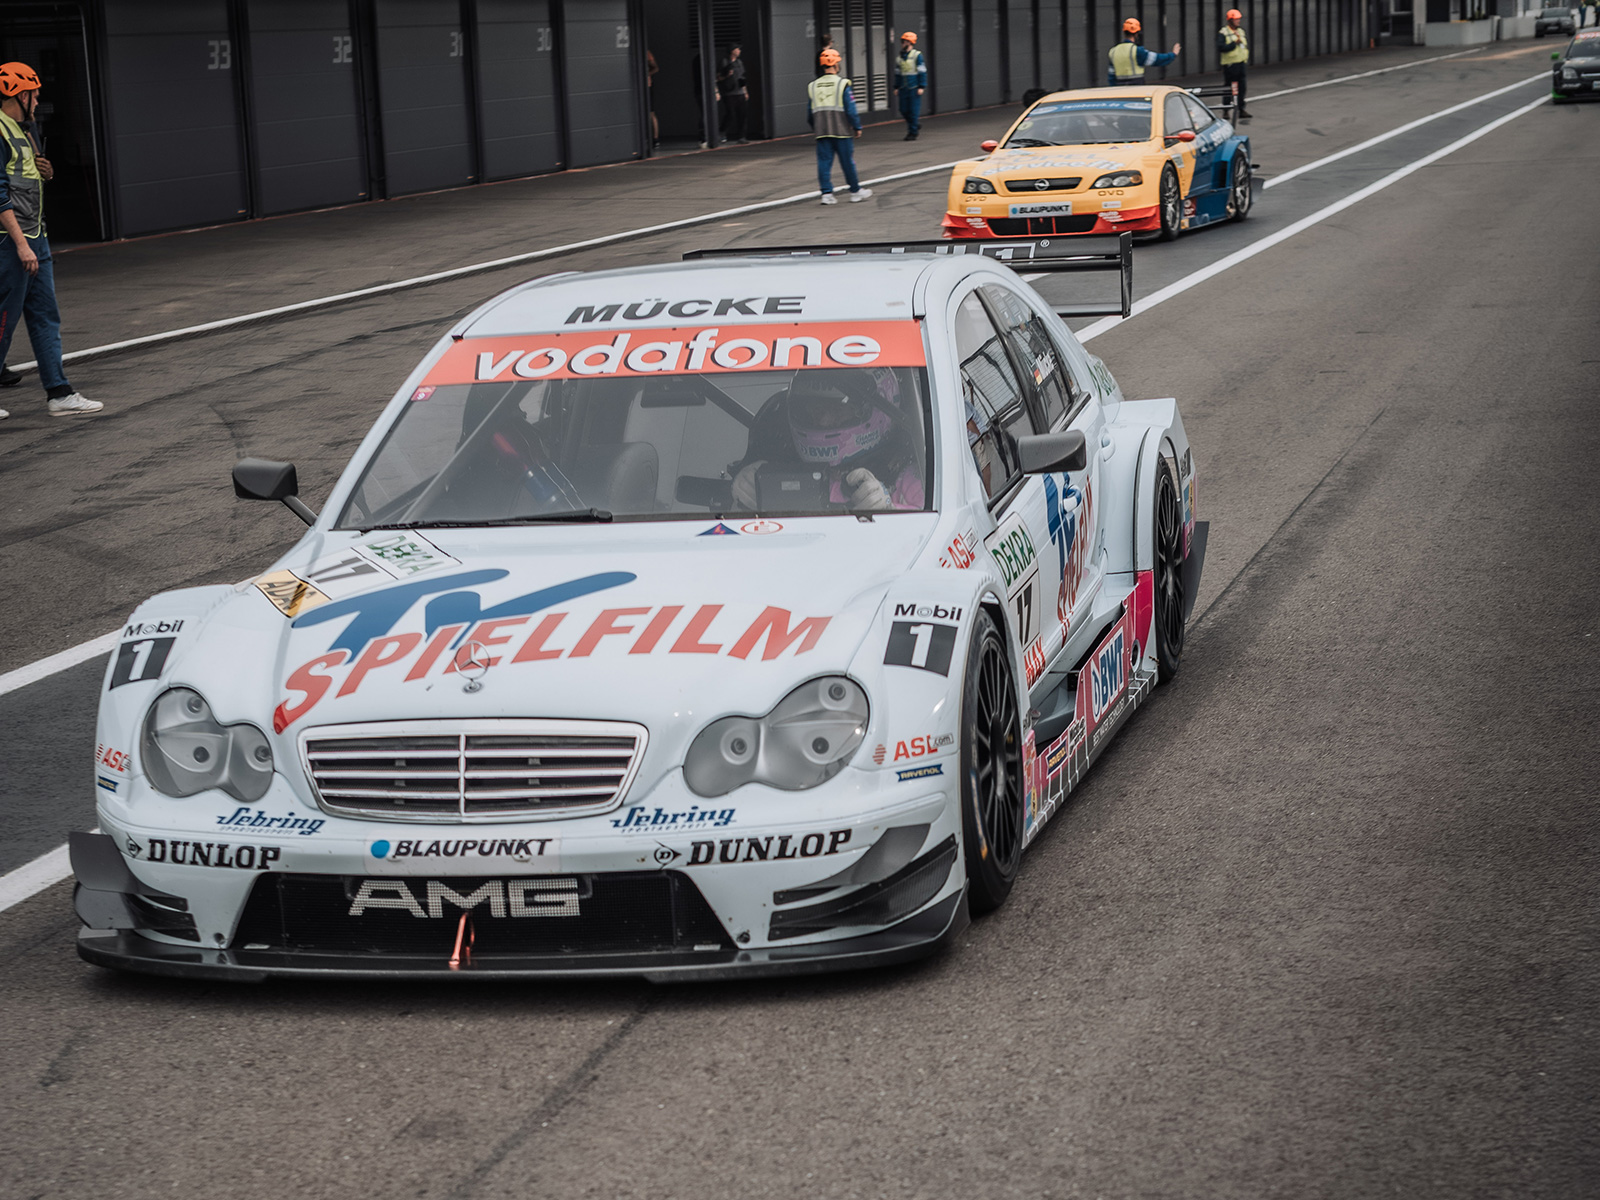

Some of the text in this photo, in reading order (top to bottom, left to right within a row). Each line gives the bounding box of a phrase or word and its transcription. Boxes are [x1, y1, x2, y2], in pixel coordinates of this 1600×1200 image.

[207, 39, 232, 70] 33
[332, 35, 353, 63] 32
[449, 31, 464, 57] 31
[1018, 204, 1070, 214] BLAUPUNKT
[563, 295, 806, 325] MÜCKE
[475, 328, 882, 381] vodafone
[808, 445, 839, 458] BWT
[366, 534, 445, 577] DEKRA
[991, 524, 1036, 587] DEKRA
[291, 568, 636, 664] TV
[894, 603, 962, 621] Mobil
[1016, 582, 1033, 648] 17
[123, 620, 185, 638] Mobil
[128, 639, 155, 682] 1
[909, 623, 934, 668] 1
[273, 604, 834, 735] SPIELFILM
[1099, 632, 1124, 710] BWT
[900, 767, 940, 780] RAVENOL
[216, 807, 326, 836] Sebring
[610, 805, 737, 827] Sebring
[147, 838, 281, 870] DUNLOP
[395, 838, 553, 858] BLAUPUNKT
[687, 828, 852, 866] DUNLOP
[348, 878, 581, 919] AMG
